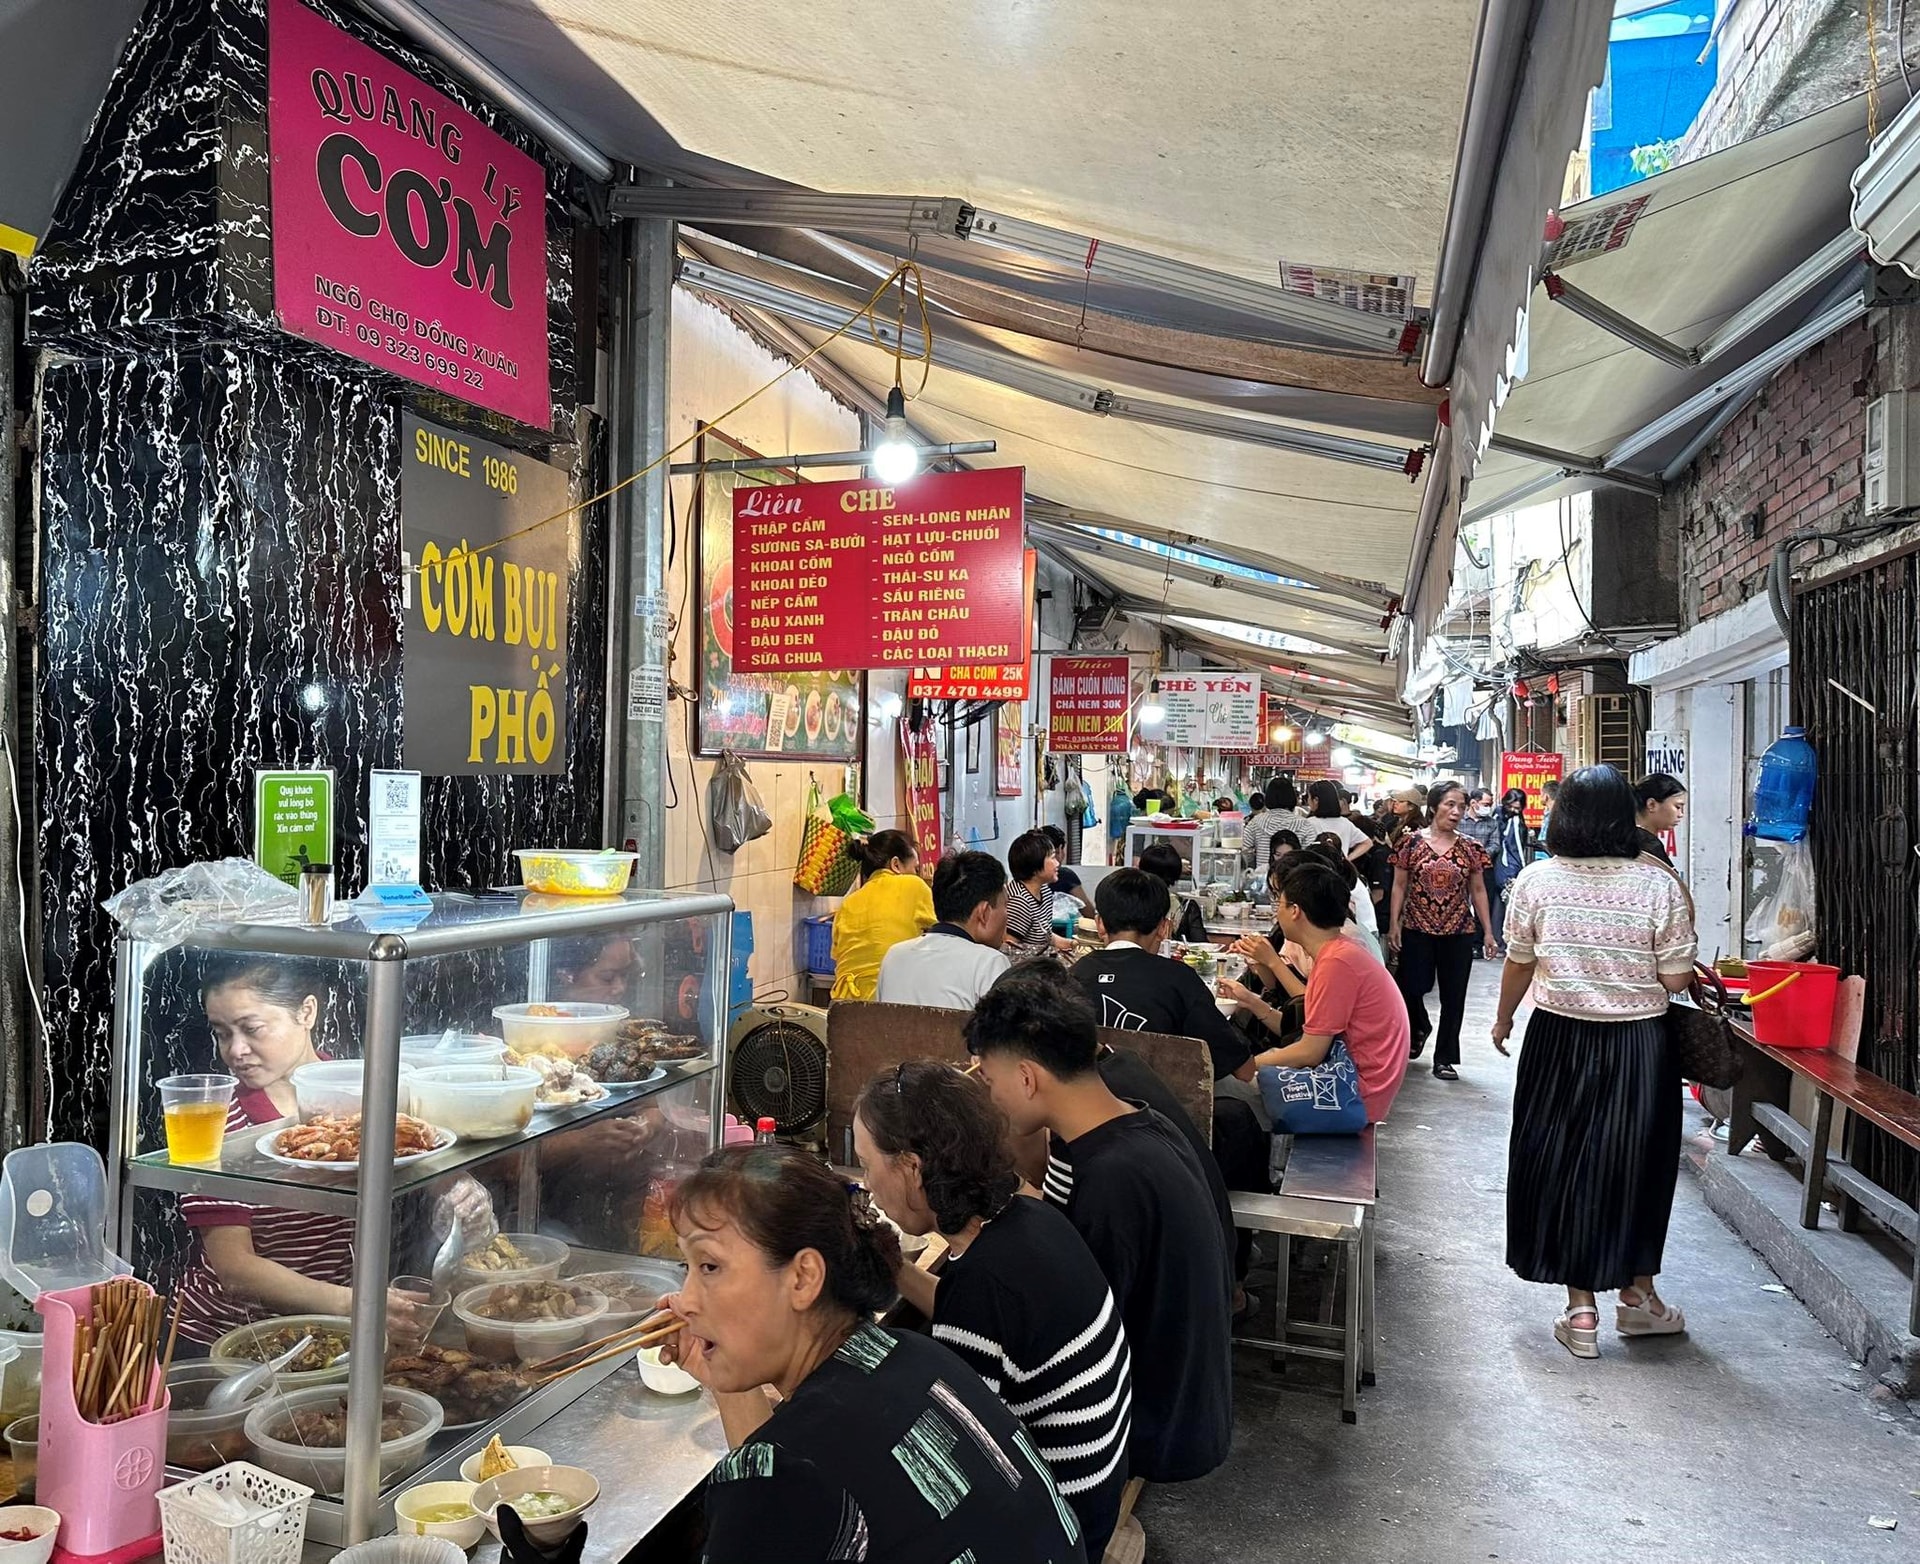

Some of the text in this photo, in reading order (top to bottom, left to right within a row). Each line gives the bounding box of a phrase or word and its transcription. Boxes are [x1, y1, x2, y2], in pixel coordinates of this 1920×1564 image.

[311, 68, 463, 164] QUANG
[316, 132, 514, 310] CƠM
[314, 274, 519, 380] NGÕ CHỢ ĐỒNG XUÂN
[316, 305, 485, 391] ĐT: 09 323 699 22
[415, 428, 518, 495] SINCE 1986
[738, 490, 804, 518] Liên
[882, 505, 1011, 527] SEN-LONG NHÃN
[750, 521, 787, 537] THẬP
[750, 533, 866, 554] SƯƠNG SA-BƯỞI
[882, 533, 912, 548] HẠT
[750, 554, 832, 573] KHOAI CỐM
[882, 546, 955, 565] NGÔ CỐM
[750, 573, 828, 591] KHOAI DẺO
[882, 569, 969, 584] THÁI-SU KA
[420, 538, 497, 642] CƠM
[502, 562, 558, 670] BỤI
[750, 594, 780, 610] NẾP
[918, 588, 966, 602] RIÊNG
[750, 614, 825, 631] ĐẬU XANH
[882, 606, 970, 622] TRÂN CHÂU
[750, 633, 815, 649] ĐẬU ĐEN
[882, 624, 939, 644] ĐẬU ĐỎ
[750, 651, 824, 665] SỮA CHUA
[882, 644, 1009, 661] CÁC LOẠI THẠCH
[1002, 667, 1023, 681] 25K
[1052, 670, 1126, 695] BÁNH CUỐN NÓNG
[913, 685, 1023, 698] 037 470 4499
[1204, 676, 1252, 692] YẾN
[1055, 696, 1122, 709] CHẢ NEM 30K
[467, 663, 562, 766] PHỐ
[1052, 711, 1074, 733] BÚN
[1076, 715, 1101, 733] NEM
